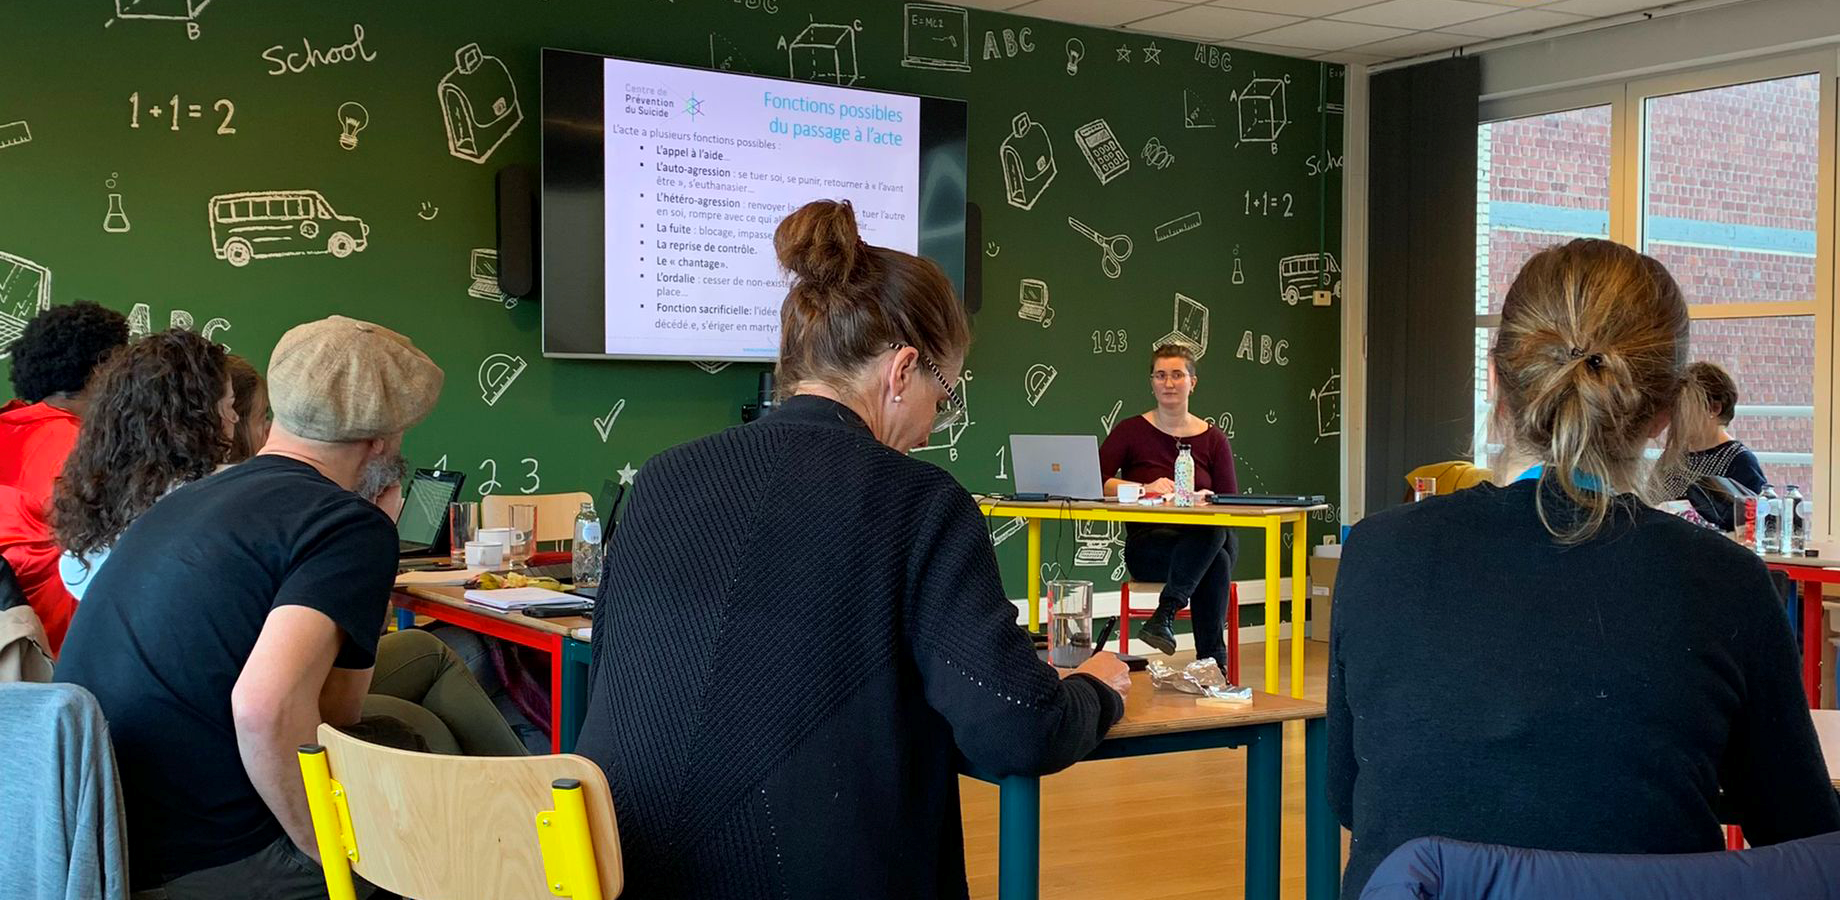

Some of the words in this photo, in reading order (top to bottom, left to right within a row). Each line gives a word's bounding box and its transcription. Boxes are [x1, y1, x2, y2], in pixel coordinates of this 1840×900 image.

[187, 22, 200, 40] B
[853, 19, 863, 32] C
[262, 24, 377, 76] School
[777, 35, 787, 50] A
[982, 27, 1035, 60] ABC
[1195, 43, 1232, 72] ABC
[1283, 74, 1291, 85] C
[625, 83, 655, 96] Centre
[657, 87, 667, 96] de
[1229, 89, 1238, 102] A
[625, 94, 674, 108] Prévention
[764, 91, 835, 115] Fonctions
[840, 104, 903, 123] possibles
[625, 105, 636, 114] du
[638, 106, 669, 117] Suicide
[613, 124, 639, 136] L'acte
[650, 128, 691, 141] plusieurs
[693, 132, 735, 146] fonctions
[737, 139, 776, 150] possibles
[769, 117, 788, 134] du
[793, 123, 850, 143] passage
[854, 126, 862, 142] à
[866, 126, 903, 146] l'acte
[656, 145, 689, 158] L'appel
[691, 148, 697, 158] à
[1271, 142, 1278, 155] B
[656, 162, 731, 177] L'auto-agression
[750, 172, 768, 180] tuer
[770, 173, 785, 184] soi,
[787, 175, 797, 184] se
[798, 177, 822, 187] punir,
[824, 179, 862, 189] retourner
[864, 181, 870, 190] à
[878, 182, 904, 192] l'avant
[656, 174, 675, 187] être
[656, 192, 741, 208] L'hétéro-agression
[748, 200, 786, 212] renvoyer
[862, 210, 879, 219] tuer
[881, 210, 905, 221] l'autre
[656, 207, 668, 216] en
[671, 208, 686, 219] soi,
[689, 210, 721, 221] rompre
[724, 211, 743, 222] avec
[746, 213, 756, 222] ce
[758, 214, 772, 225] qui
[656, 223, 667, 233] La
[669, 223, 691, 235] fuite
[699, 226, 736, 239] blocage,
[656, 239, 667, 250] La
[669, 241, 701, 253] reprise
[704, 241, 715, 252] de
[717, 243, 758, 255] contrôle.
[656, 256, 667, 266] Le
[656, 272, 696, 284] L'ordalie
[703, 275, 730, 285] cesser
[733, 276, 744, 286] de
[656, 302, 696, 314] Fonction
[699, 304, 752, 316] sacrificielle:
[754, 306, 778, 317] l'idée
[701, 321, 734, 332] s'ériger
[736, 322, 748, 332] en
[749, 323, 778, 333] martyr
[1092, 329, 1128, 353] 123
[1236, 330, 1289, 366] ABC
[964, 370, 973, 381] C
[949, 448, 958, 461] B
[478, 459, 501, 495] 2
[520, 458, 540, 494] 3
